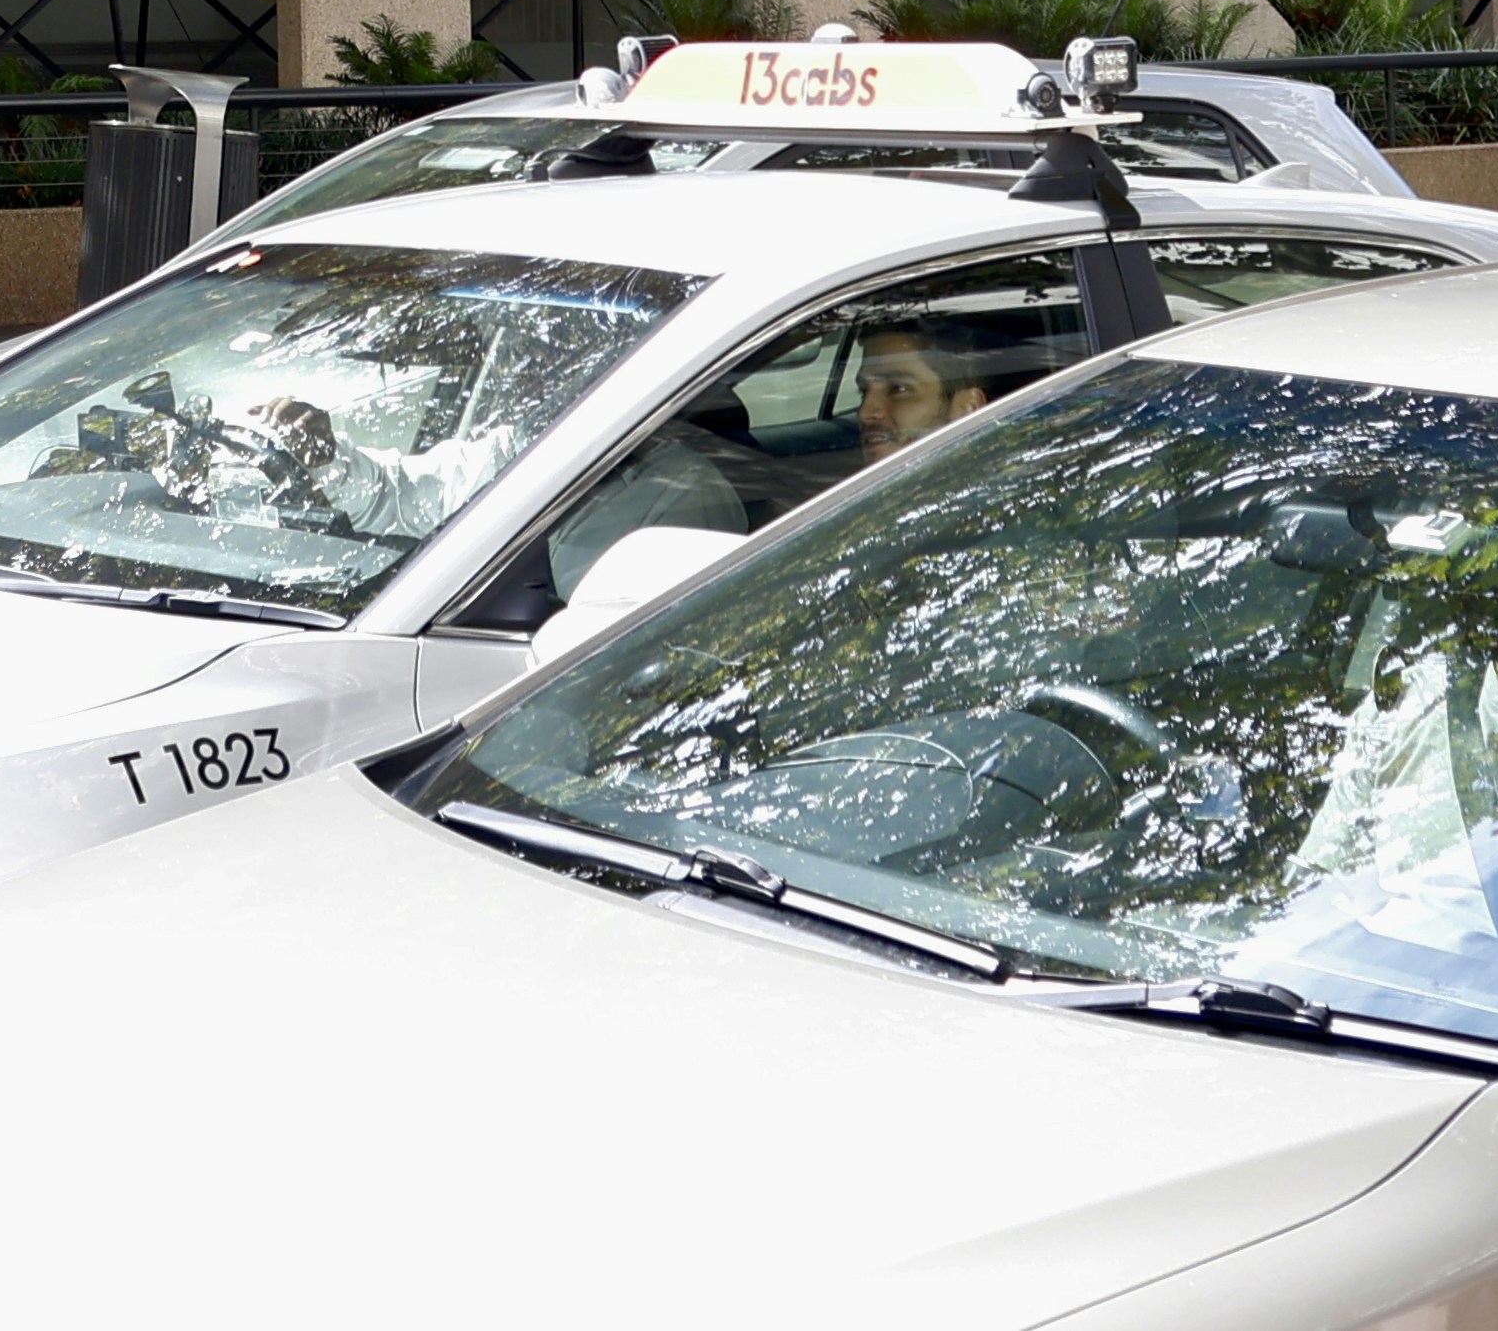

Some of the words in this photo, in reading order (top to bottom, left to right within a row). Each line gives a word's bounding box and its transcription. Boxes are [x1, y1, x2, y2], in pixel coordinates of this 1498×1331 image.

[740, 52, 878, 107] 13cabs
[108, 751, 146, 805] T
[162, 727, 290, 795] 1823
